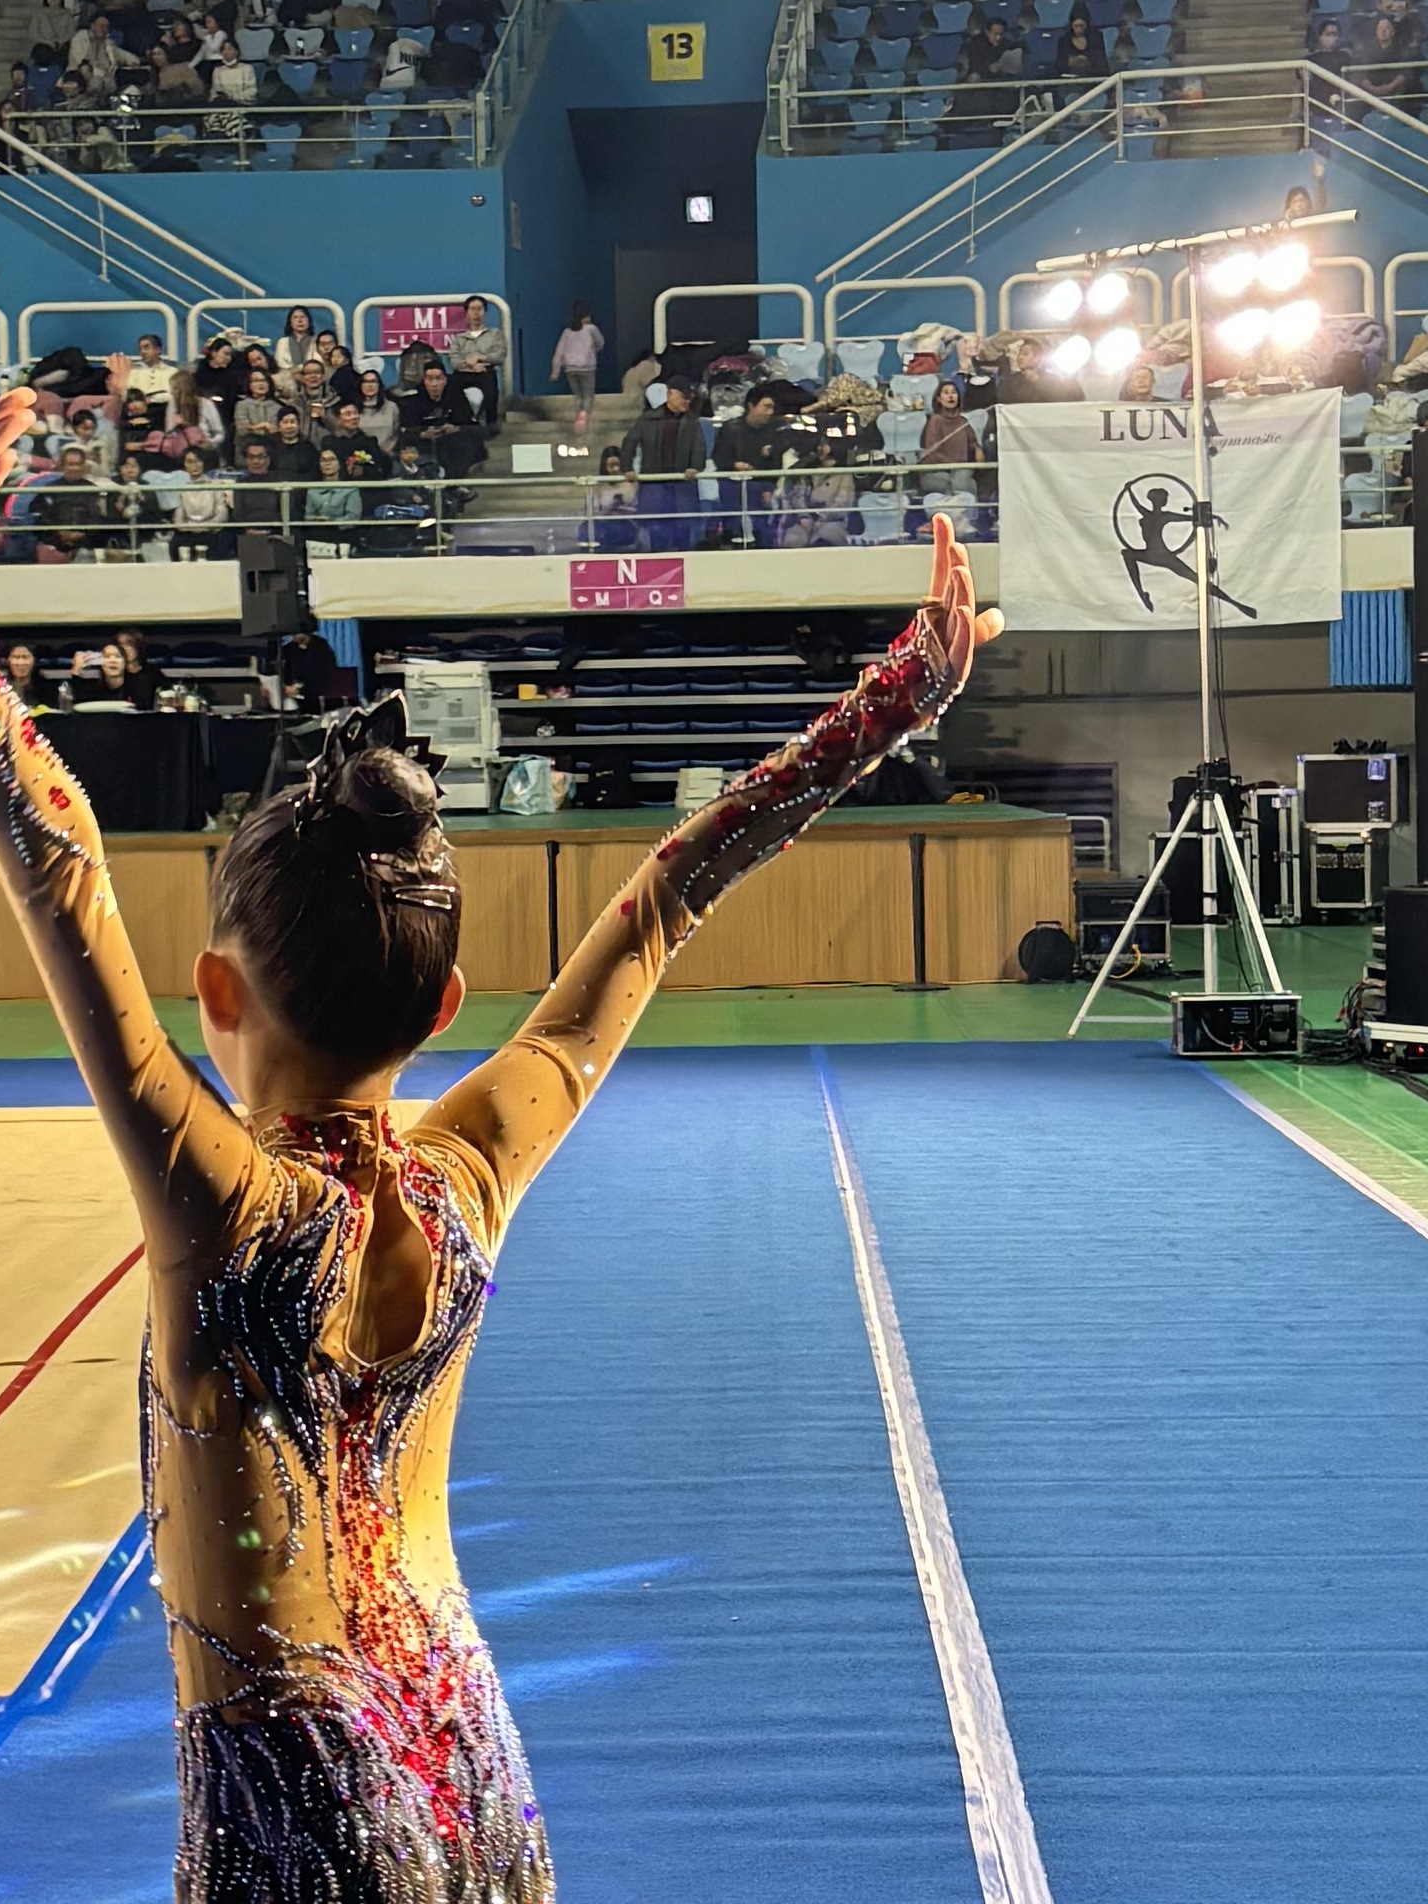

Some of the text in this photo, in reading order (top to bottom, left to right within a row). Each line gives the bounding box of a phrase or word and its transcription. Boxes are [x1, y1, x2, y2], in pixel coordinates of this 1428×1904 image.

[661, 32, 694, 60] 13
[414, 306, 447, 329] M1
[1099, 400, 1223, 442] LUNA
[618, 559, 637, 584] N
[595, 591, 610, 606] M
